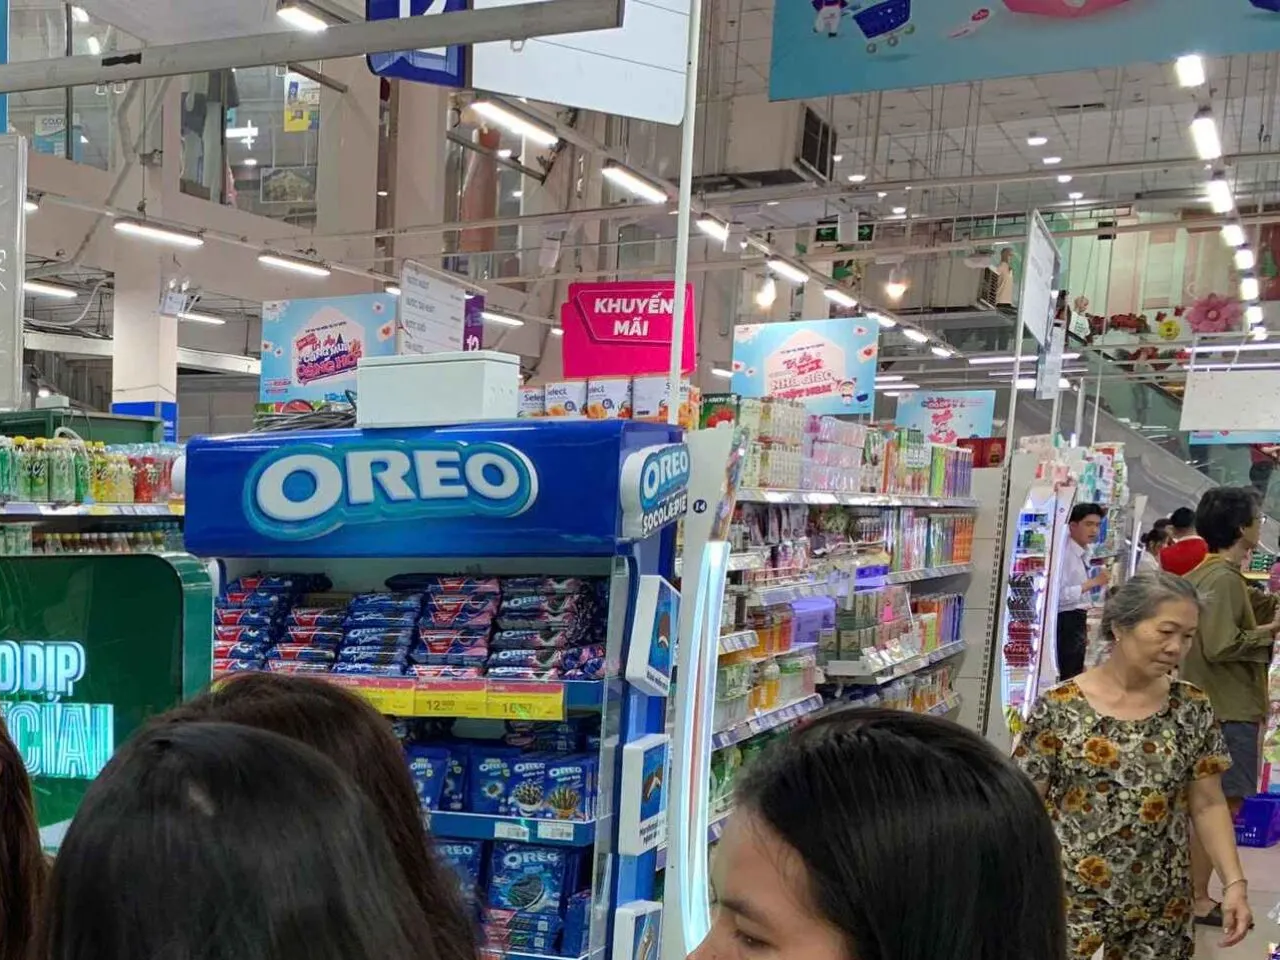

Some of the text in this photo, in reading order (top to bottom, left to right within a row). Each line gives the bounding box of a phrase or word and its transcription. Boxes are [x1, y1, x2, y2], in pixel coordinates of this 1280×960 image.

[594, 291, 675, 315] KHUYẾN
[613, 317, 649, 336] MÃI
[643, 451, 689, 500] OREO
[256, 449, 521, 523] OREO
[514, 762, 546, 773] OREO
[548, 766, 583, 777] OREO
[439, 845, 474, 856] REO
[504, 852, 559, 868] OREO
